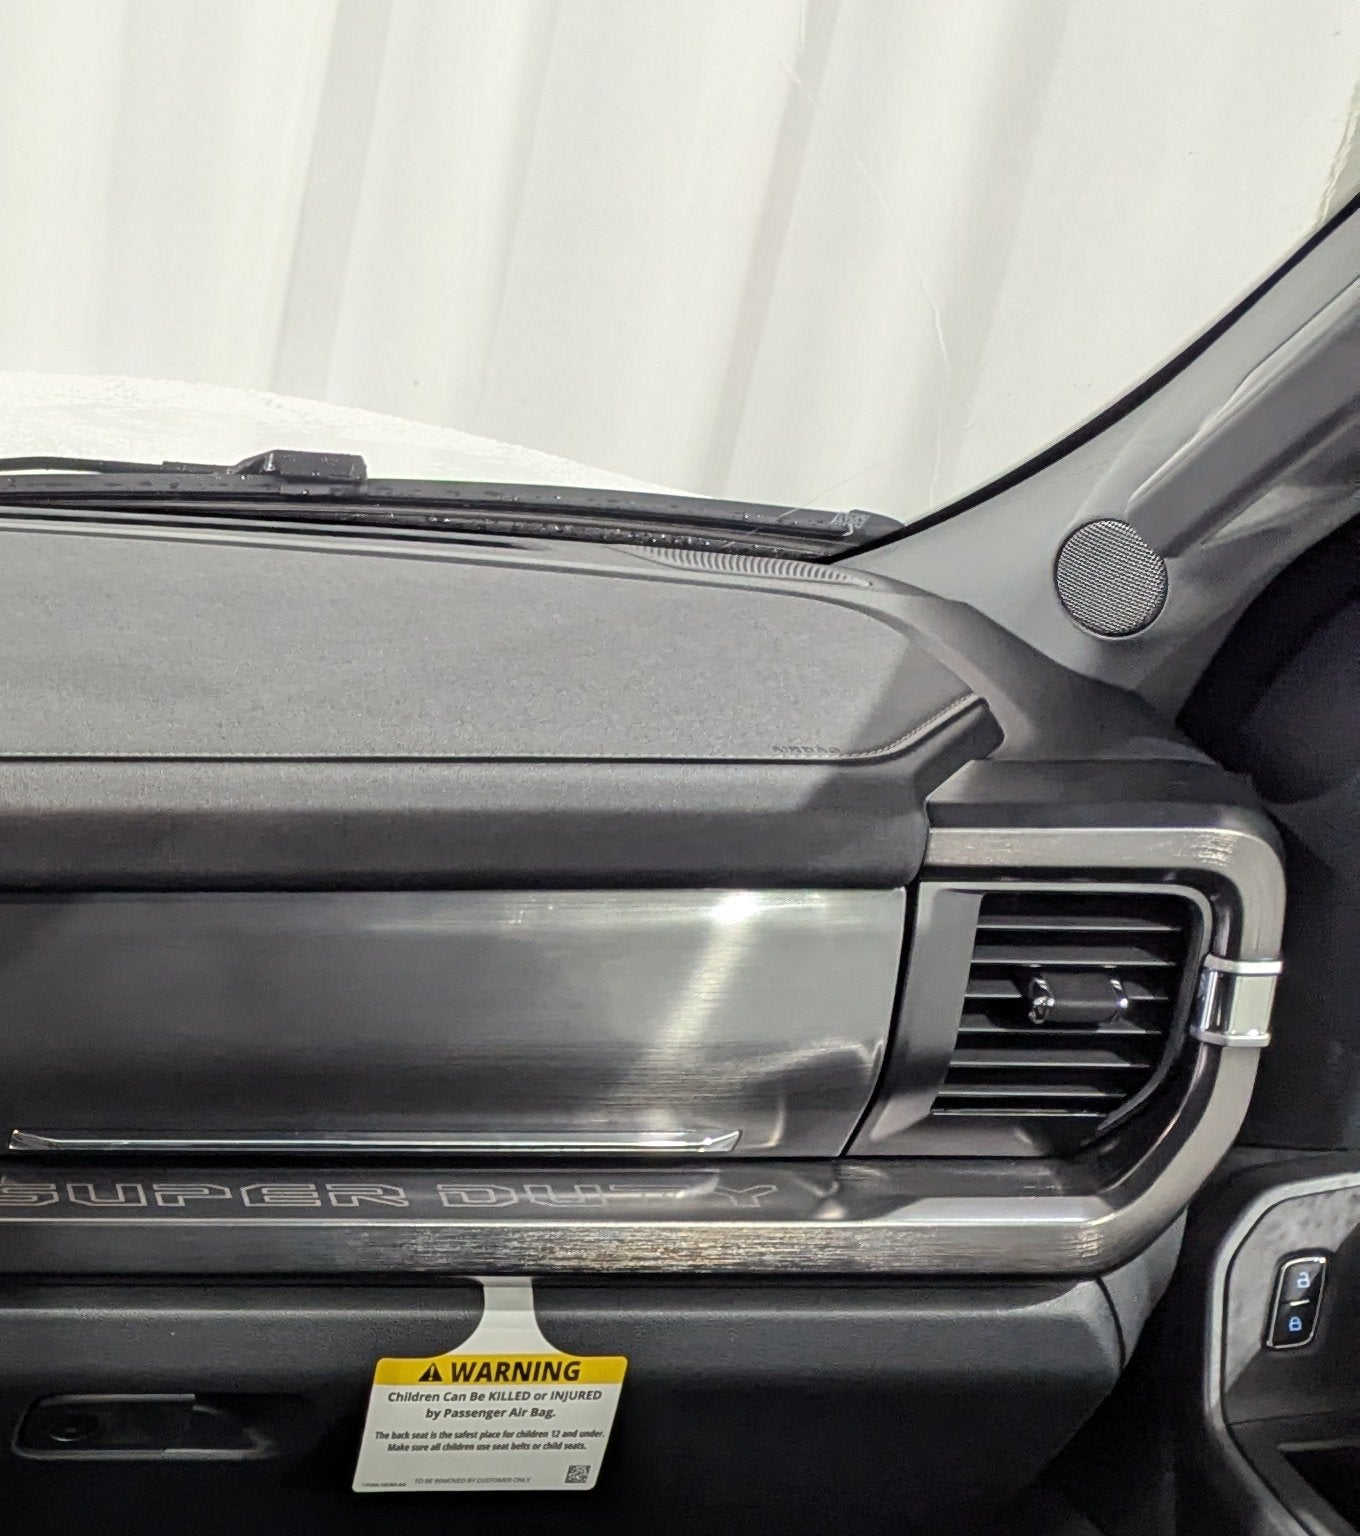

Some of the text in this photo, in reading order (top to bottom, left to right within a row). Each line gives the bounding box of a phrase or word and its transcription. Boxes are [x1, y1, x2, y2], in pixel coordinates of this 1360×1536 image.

[450, 1361, 582, 1383] WARNING
[387, 1389, 603, 1403] Children Can Be KILLED or INJURED
[425, 1407, 557, 1420] by Passenger Air Bag.
[375, 1431, 390, 1440] The
[391, 1430, 410, 1440] back
[412, 1431, 429, 1440] seat
[439, 1430, 453, 1439] the
[454, 1430, 478, 1439] safest
[479, 1430, 501, 1441] place
[502, 1430, 516, 1439] for
[516, 1429, 549, 1439] children
[551, 1429, 561, 1439] 12
[562, 1429, 579, 1438] and
[387, 1442, 410, 1451] Make
[411, 1443, 429, 1451] sure
[430, 1442, 441, 1451] all
[442, 1442, 475, 1451] children
[476, 1443, 491, 1451] use
[492, 1443, 509, 1451] seat
[510, 1442, 531, 1451] belts
[542, 1441, 563, 1450] child
